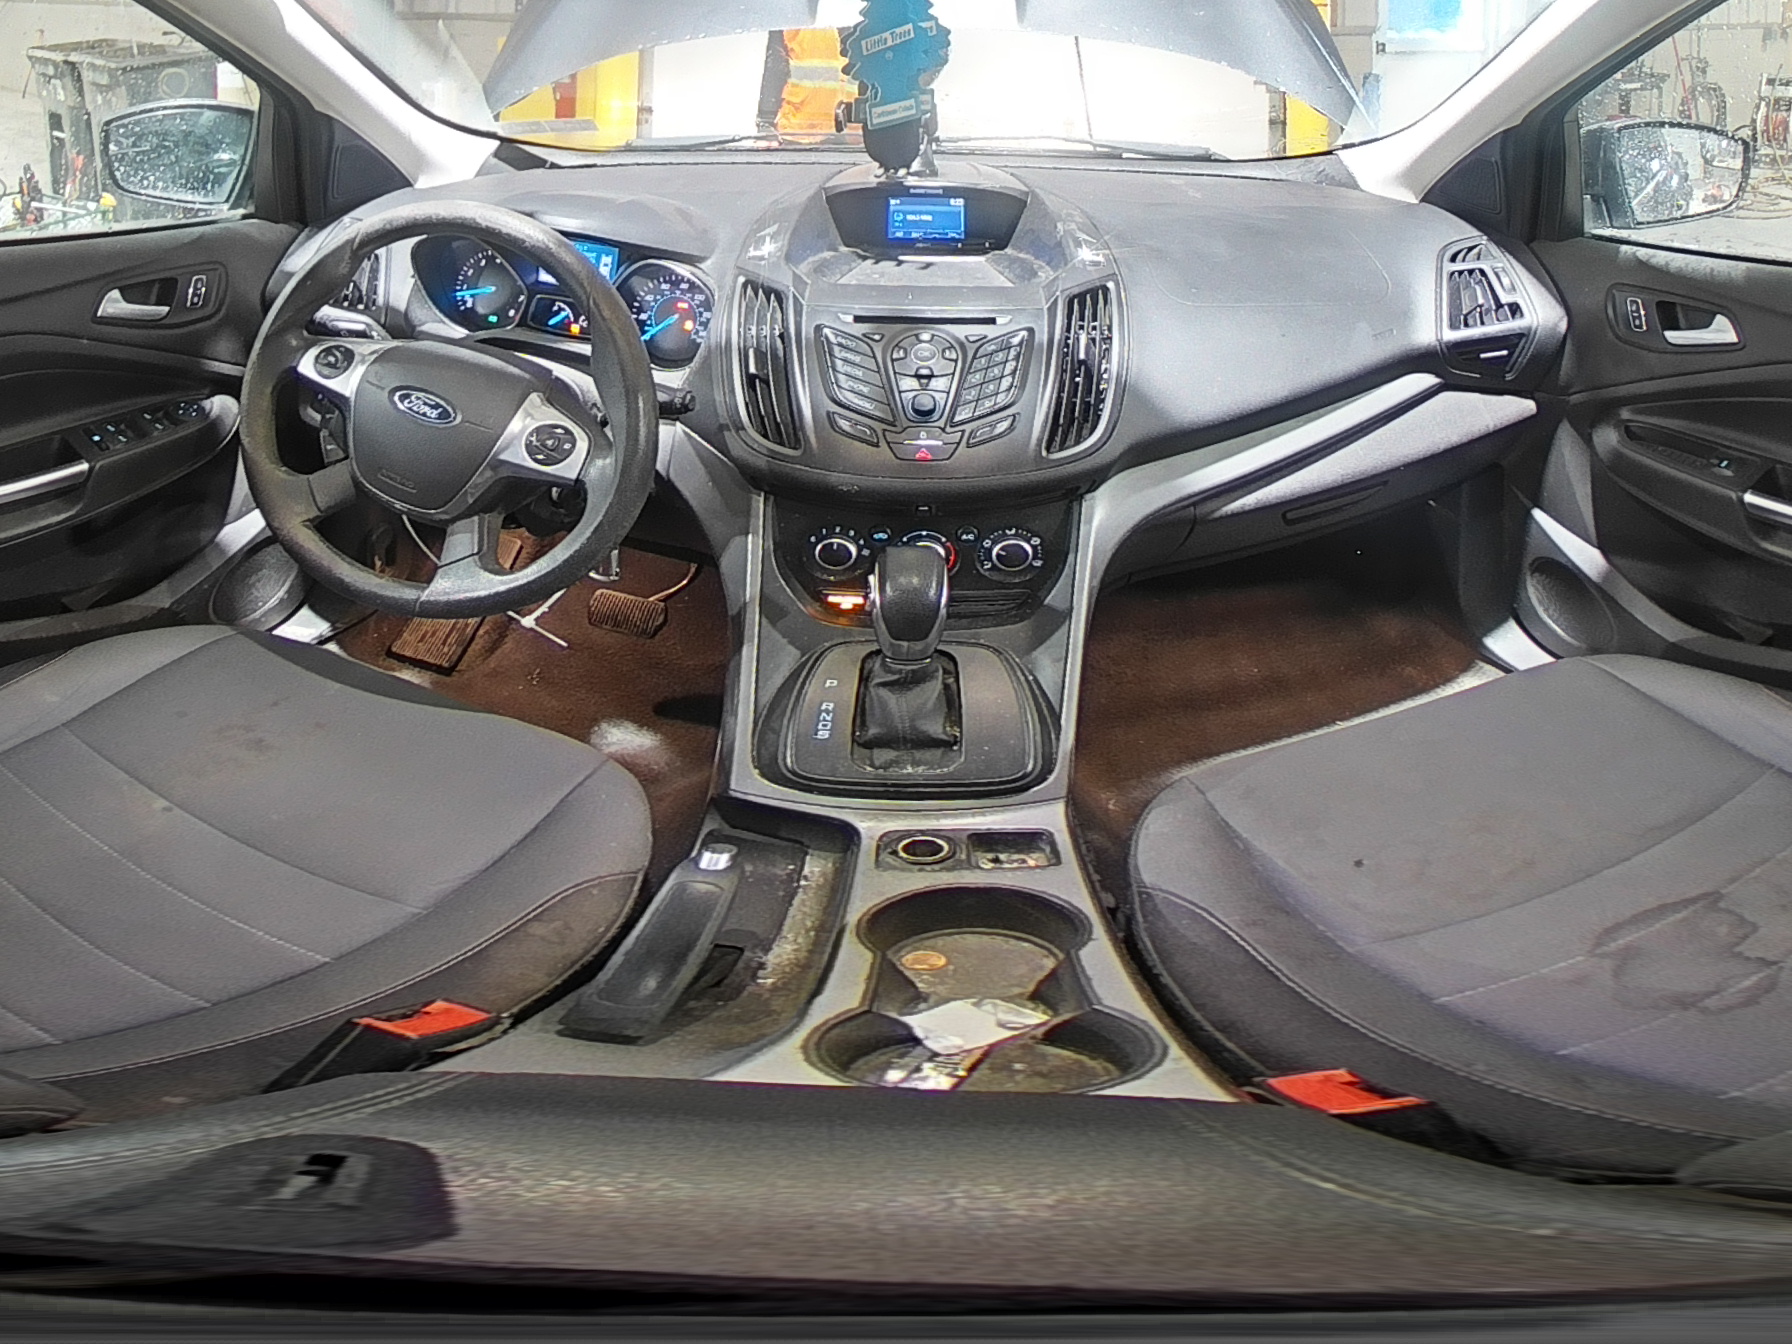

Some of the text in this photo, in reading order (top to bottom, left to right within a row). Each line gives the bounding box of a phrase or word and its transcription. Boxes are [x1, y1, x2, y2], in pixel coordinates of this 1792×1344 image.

[864, 27, 913, 53] Little Trees
[403, 393, 444, 419] Ford
[824, 679, 838, 688] P
[820, 701, 835, 711] R
[819, 712, 833, 721] N
